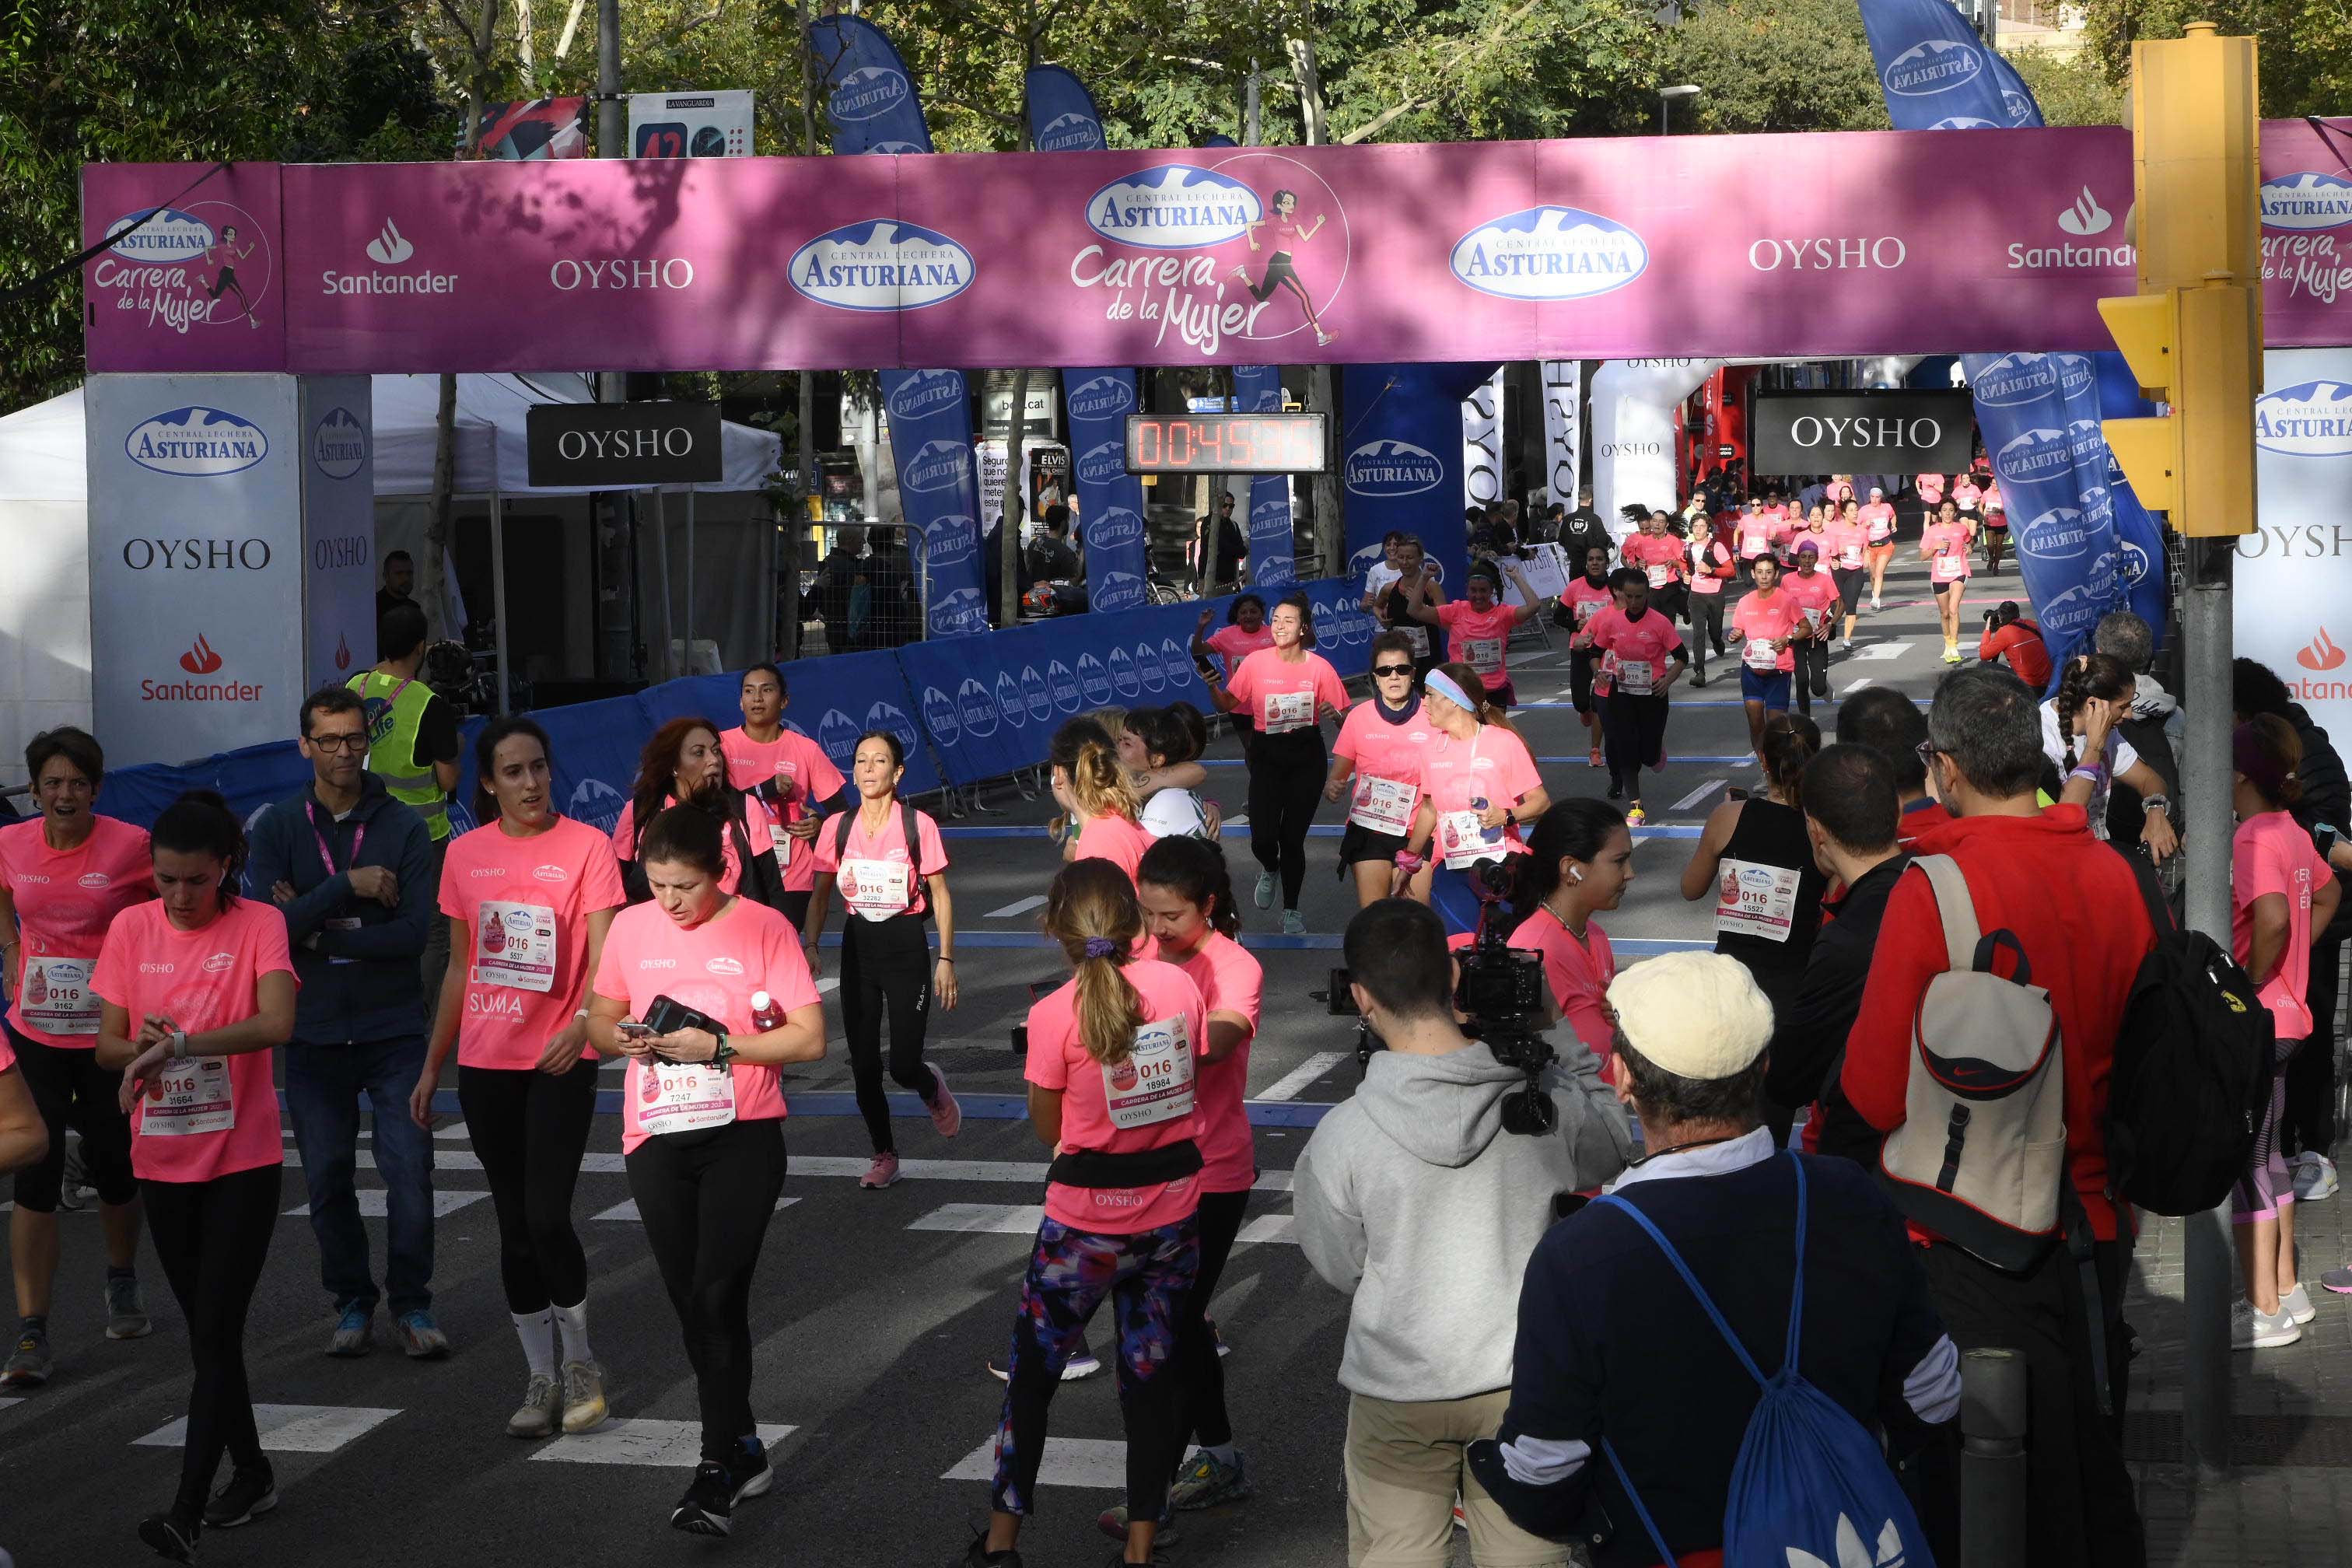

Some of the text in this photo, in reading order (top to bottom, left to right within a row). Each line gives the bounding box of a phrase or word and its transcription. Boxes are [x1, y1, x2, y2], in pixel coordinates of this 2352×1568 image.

[1126, 192, 1244, 202] CENTRAL LECHERA
[1099, 196, 1248, 229] ASTURIANA
[113, 229, 206, 249] ASTURIANA
[1496, 237, 1627, 250] CENTRAL LECHERA
[2261, 235, 2336, 257] arrera
[831, 250, 954, 261] CENTRAL LECHERA
[1465, 242, 1633, 277] ASTURIANA
[1748, 236, 1906, 271] OYSHO
[2007, 241, 2137, 269] Santand
[94, 259, 187, 289] Carrera
[551, 258, 694, 290] OYSHO
[801, 253, 961, 289] ASTURIANA
[1070, 245, 1216, 289] Carrera
[323, 270, 458, 295] Santander
[2279, 258, 2294, 279] la
[2290, 254, 2352, 304] Muje
[117, 285, 221, 334] de la Mujer
[1106, 283, 1271, 355] de la Mujer
[2277, 407, 2328, 416] CENTRAL
[1546, 361, 1575, 498] OYSH
[1791, 416, 1941, 448] OYSHO
[136, 432, 258, 460] ASTURIANA
[317, 436, 362, 462] ASTURIANA
[558, 428, 692, 460] OYSHO
[1601, 443, 1660, 457] OYSHO
[1041, 455, 1066, 464] ELVIS
[984, 467, 996, 476] que
[1349, 464, 1436, 485] ASTURIANA
[984, 499, 999, 507] este
[122, 538, 271, 571] OYSHO
[315, 535, 367, 571] OYSHO
[141, 678, 263, 702] Santander
[1373, 797, 1392, 809] 016
[17, 874, 50, 884] OYSHO
[471, 868, 506, 878] OYSHO
[860, 884, 884, 893] 016
[1742, 891, 1767, 904] 016
[1723, 909, 1744, 919] CARRERA
[1744, 905, 1764, 913] 15522
[1720, 919, 1744, 929] OYSHO
[508, 936, 528, 950] 016
[510, 951, 523, 961] 5537
[140, 962, 173, 973] OYSHO
[641, 959, 676, 970] OYSHO
[485, 971, 508, 980] OYSHO
[523, 976, 548, 985] Santander
[50, 988, 79, 999] 016
[470, 992, 524, 1015] SUMA
[1140, 1059, 1172, 1079] 016
[164, 1078, 194, 1093] 016
[663, 1076, 697, 1091] 016
[1146, 1077, 1171, 1090] 18984
[169, 1095, 193, 1104] 31664
[670, 1094, 691, 1102] 7247
[1121, 1097, 1150, 1105] CARRERA
[1166, 1087, 1183, 1095] MUJER
[646, 1108, 669, 1118] CARRERA
[696, 1112, 729, 1123] Santander
[1120, 1108, 1152, 1122] OYSHO
[149, 1121, 176, 1129] OYSHO
[197, 1116, 227, 1125] Santander
[1096, 1194, 1143, 1206] OYSHO
